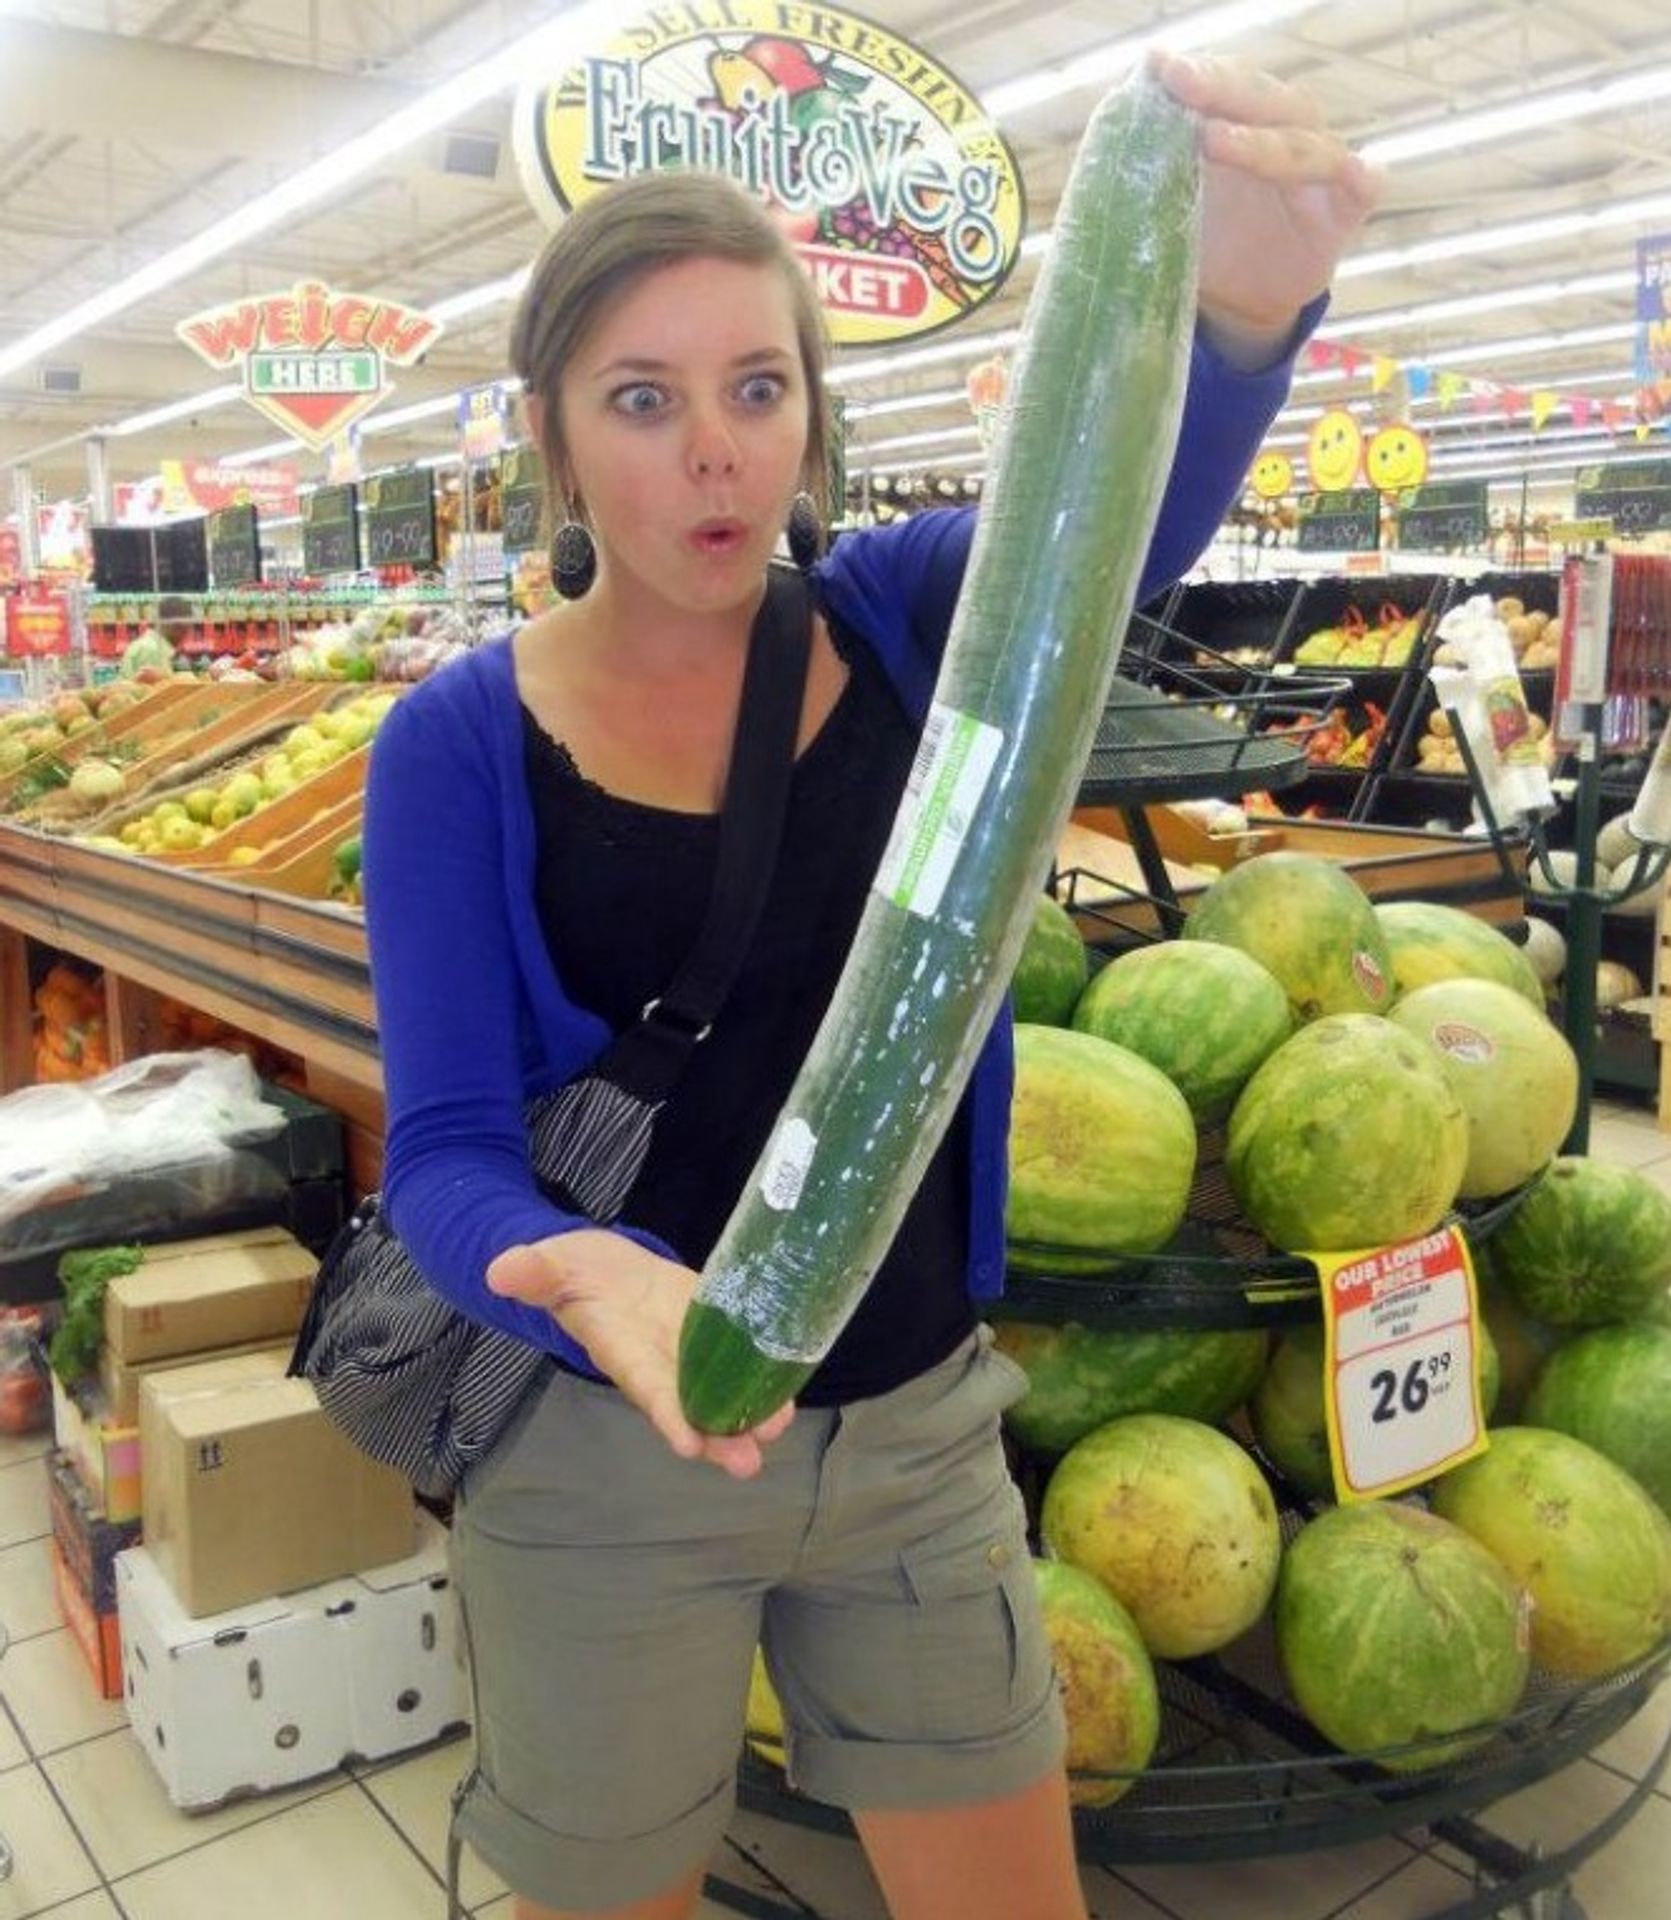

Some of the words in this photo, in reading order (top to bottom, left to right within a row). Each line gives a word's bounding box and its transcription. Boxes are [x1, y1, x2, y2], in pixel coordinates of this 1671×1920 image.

[806, 258, 908, 309] KET
[272, 360, 356, 388] HERE
[1335, 1260, 1379, 1291] OUR
[1370, 1361, 1428, 1423] 26
[1428, 1352, 1451, 1377] 99
